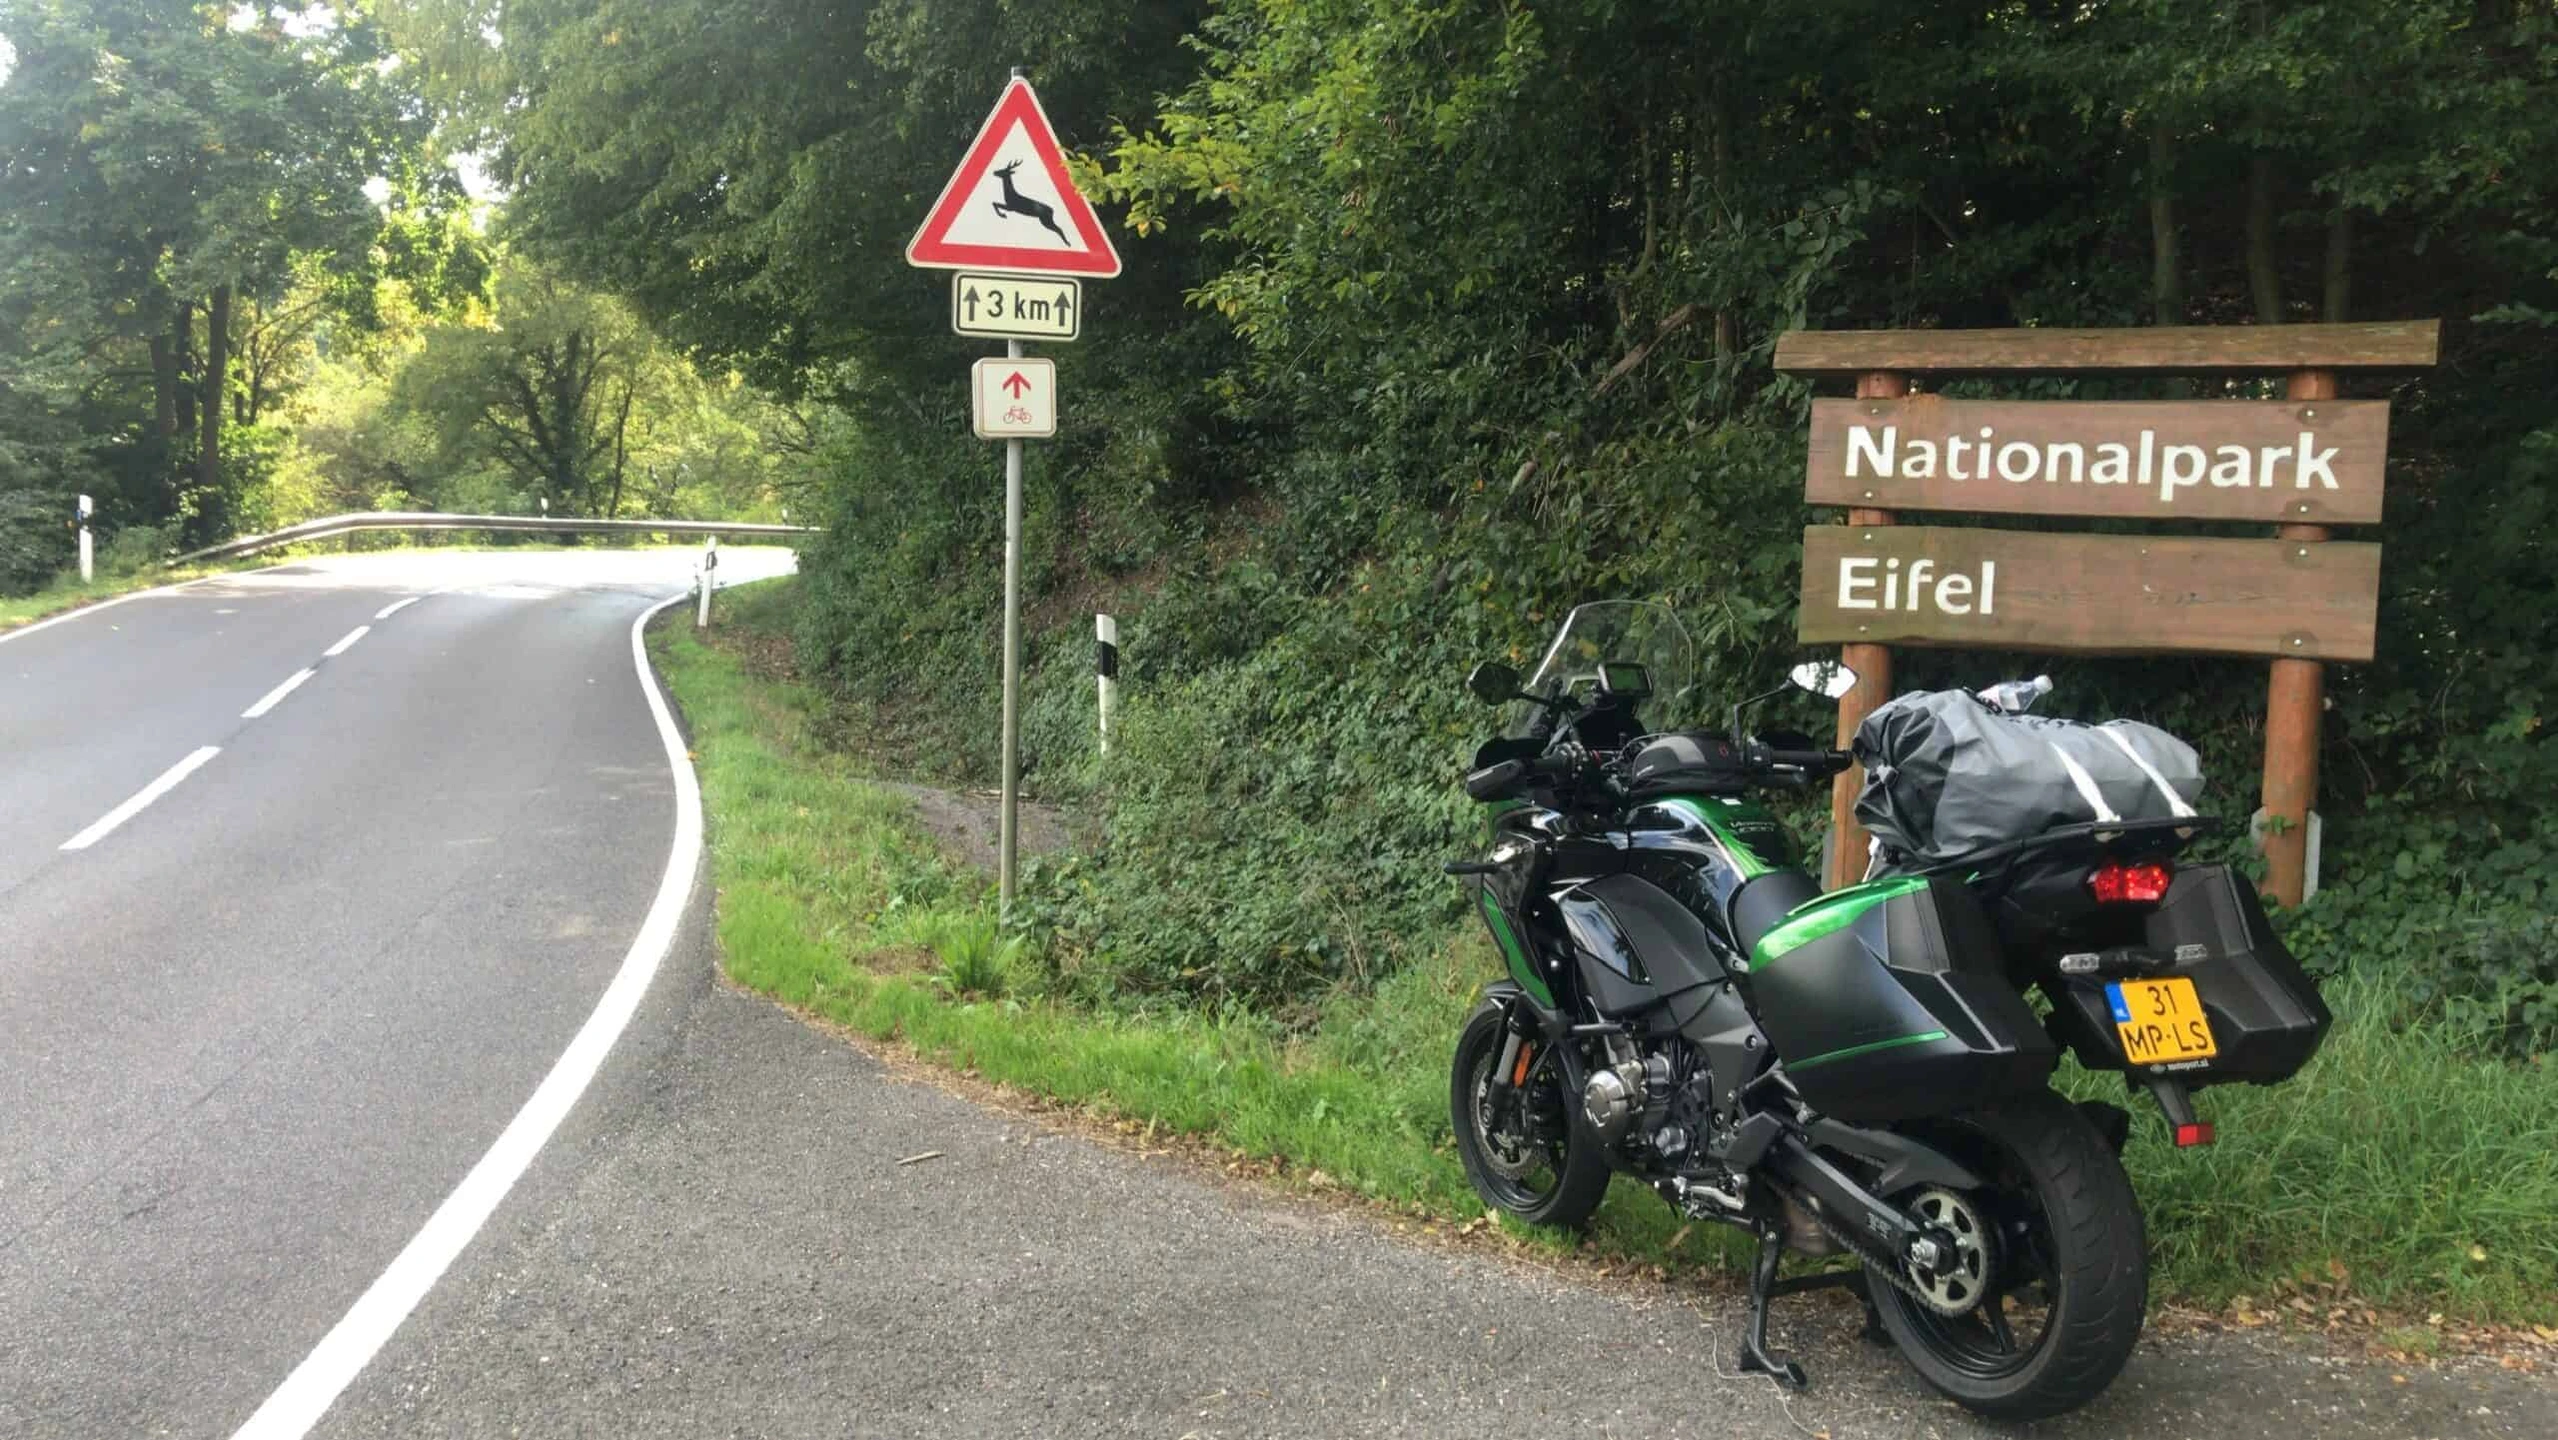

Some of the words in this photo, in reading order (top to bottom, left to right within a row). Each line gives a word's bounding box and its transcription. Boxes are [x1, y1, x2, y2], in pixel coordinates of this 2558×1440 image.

[987, 290, 1004, 318] 3
[1014, 291, 1050, 321] km
[1845, 425, 2340, 502] Nationalpark
[1838, 557, 1995, 615] Eifel
[2147, 985, 2178, 1016] 31
